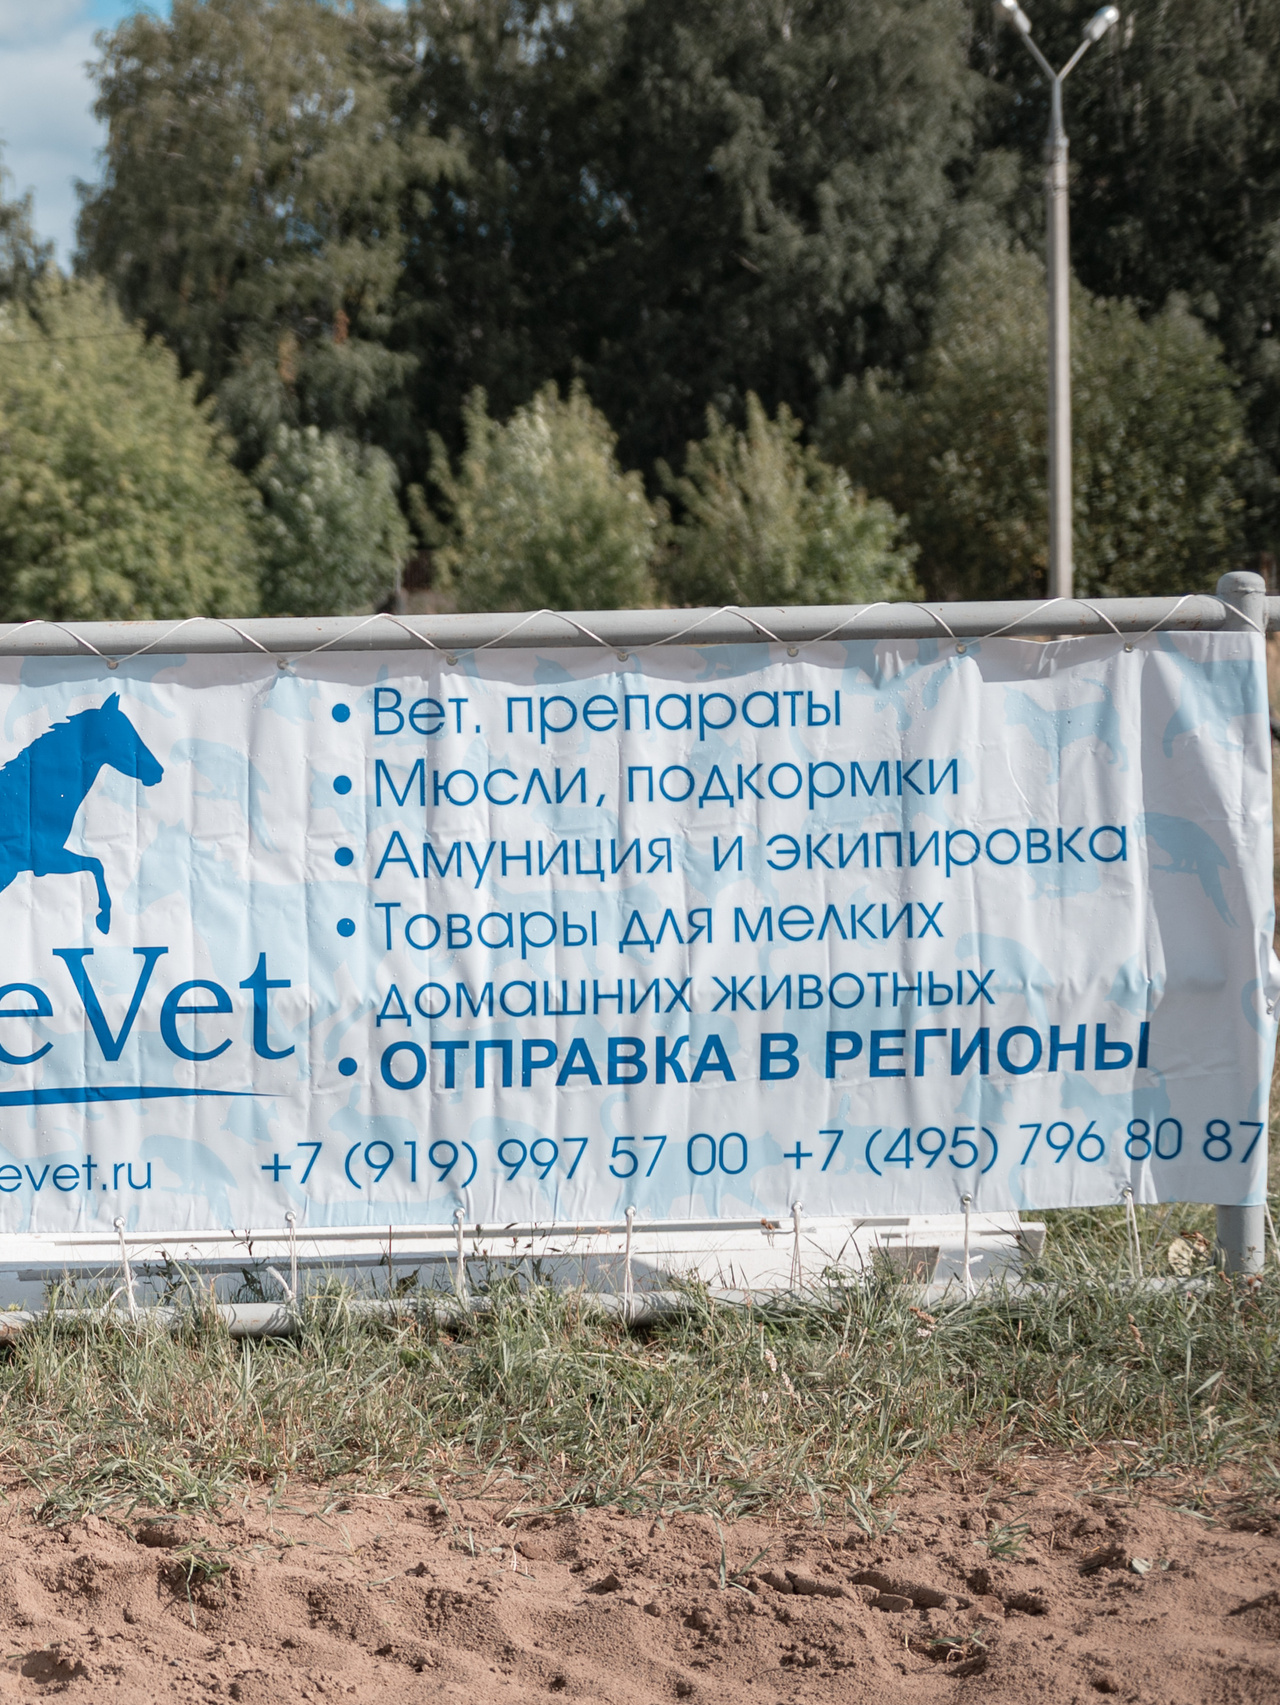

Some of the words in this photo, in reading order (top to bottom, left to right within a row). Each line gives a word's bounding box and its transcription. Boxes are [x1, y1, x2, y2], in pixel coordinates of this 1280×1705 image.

[373, 687, 481, 736] Вет.
[507, 690, 841, 745] препараты
[375, 758, 606, 807] Мюсли,
[627, 758, 959, 810] подкормки
[374, 830, 672, 889] Амуниция
[713, 835, 743, 872] и
[766, 825, 1128, 878] экипировка
[374, 902, 598, 960] Товары
[619, 907, 713, 954] для
[734, 902, 945, 943] мелких
[375, 977, 693, 1028] домашних
[711, 969, 996, 1012] животных
[380, 1033, 737, 1091] ОТПРАВКА
[759, 1032, 800, 1081] В
[825, 1021, 1151, 1079] РЕГИОНЫ
[261, 1141, 323, 1184] +7
[344, 1139, 478, 1190] (919)
[497, 1137, 589, 1181] 997
[608, 1135, 667, 1179] 57
[686, 1132, 748, 1176] 00
[783, 1129, 844, 1172] +7
[865, 1126, 999, 1177] (495)
[1019, 1120, 1105, 1165] 796
[1124, 1117, 1183, 1162] 80
[1201, 1118, 1265, 1164] 87
